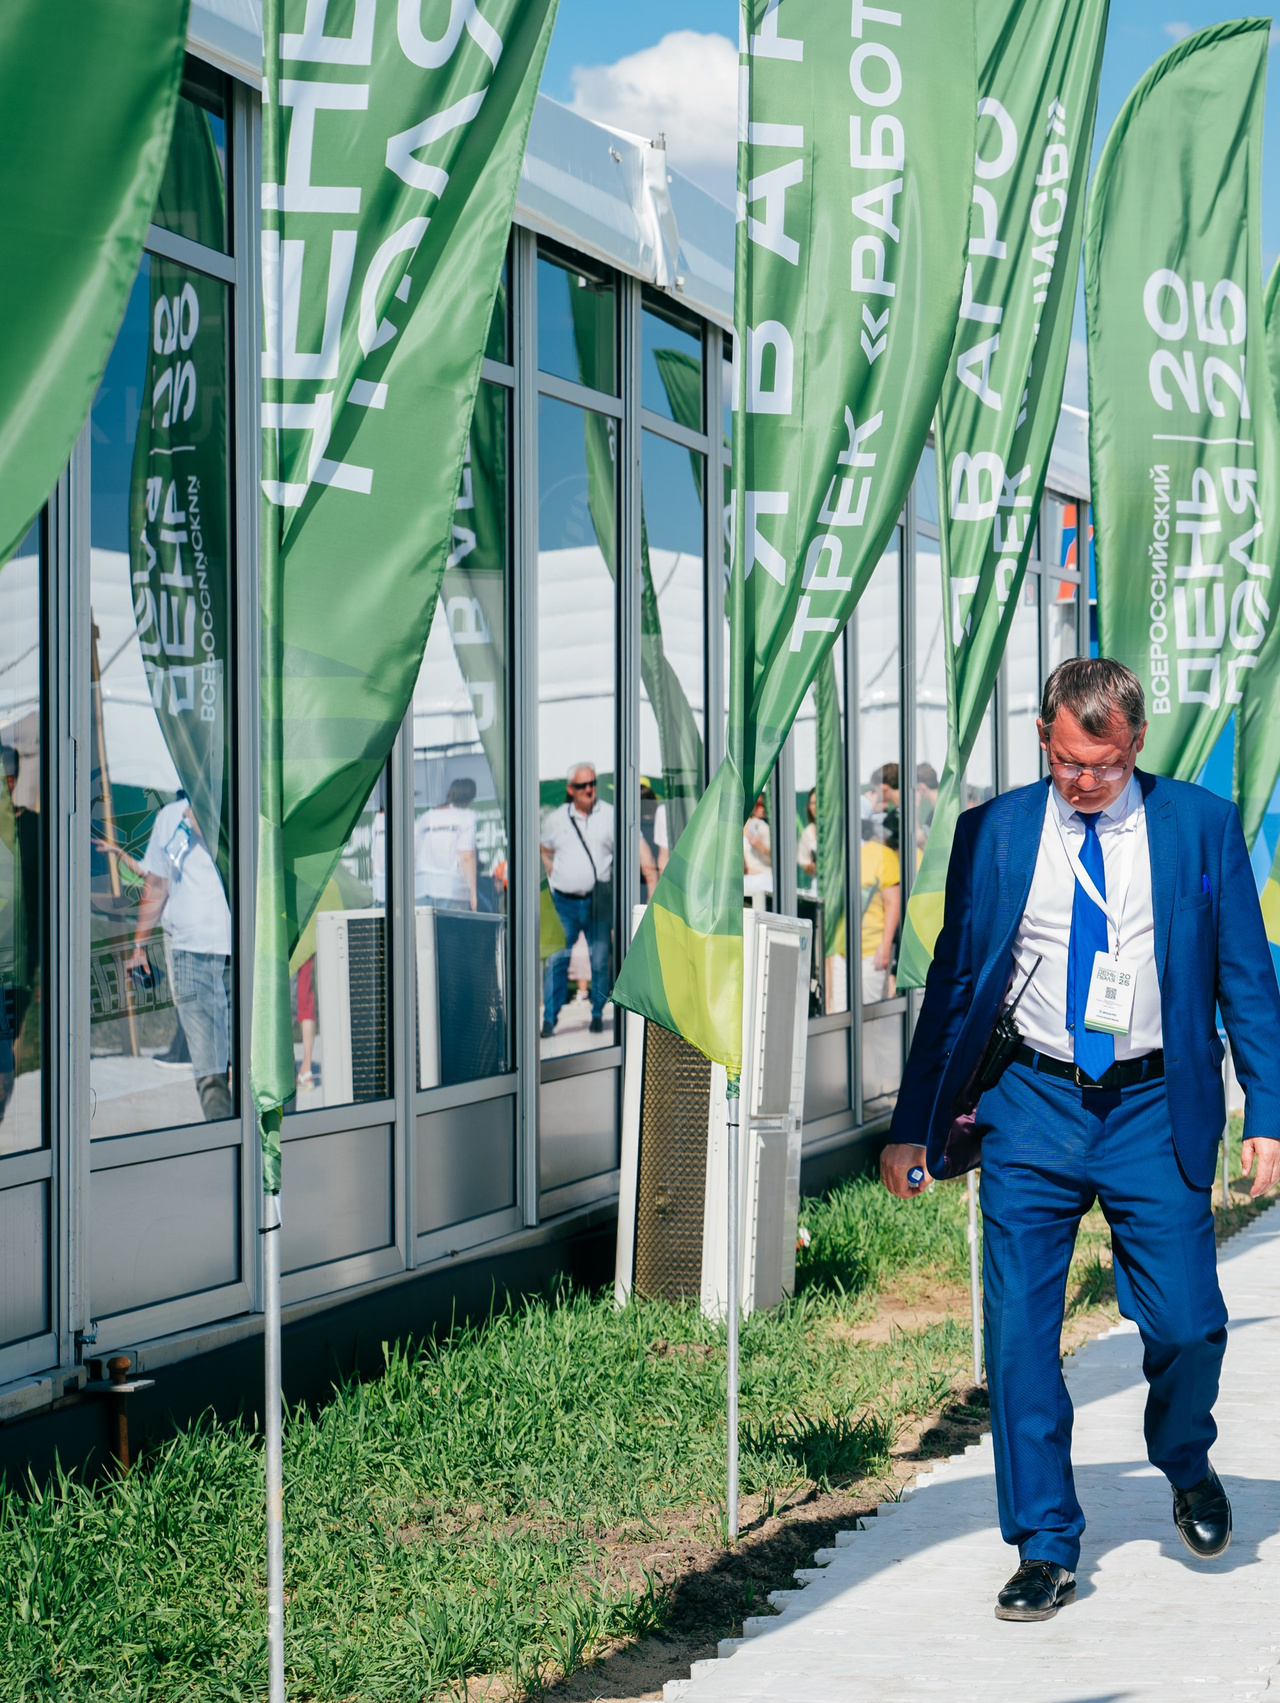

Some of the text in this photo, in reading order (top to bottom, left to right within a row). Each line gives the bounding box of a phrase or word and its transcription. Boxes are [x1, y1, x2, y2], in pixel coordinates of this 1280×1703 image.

[789, 0, 905, 652] ТРЕК «РАБОТ
[956, 96, 1018, 412] АГРО
[732, 317, 794, 415] В
[1143, 268, 1201, 415] 20
[1192, 278, 1251, 421] 25
[950, 451, 1004, 521] В
[992, 463, 1033, 624] РЕК
[1148, 463, 1172, 714] ВСЕРОССИЙСКИЙ
[1173, 466, 1226, 711] ДЕНЬ
[1118, 978, 1129, 986] 25
[1119, 972, 1130, 980] 20
